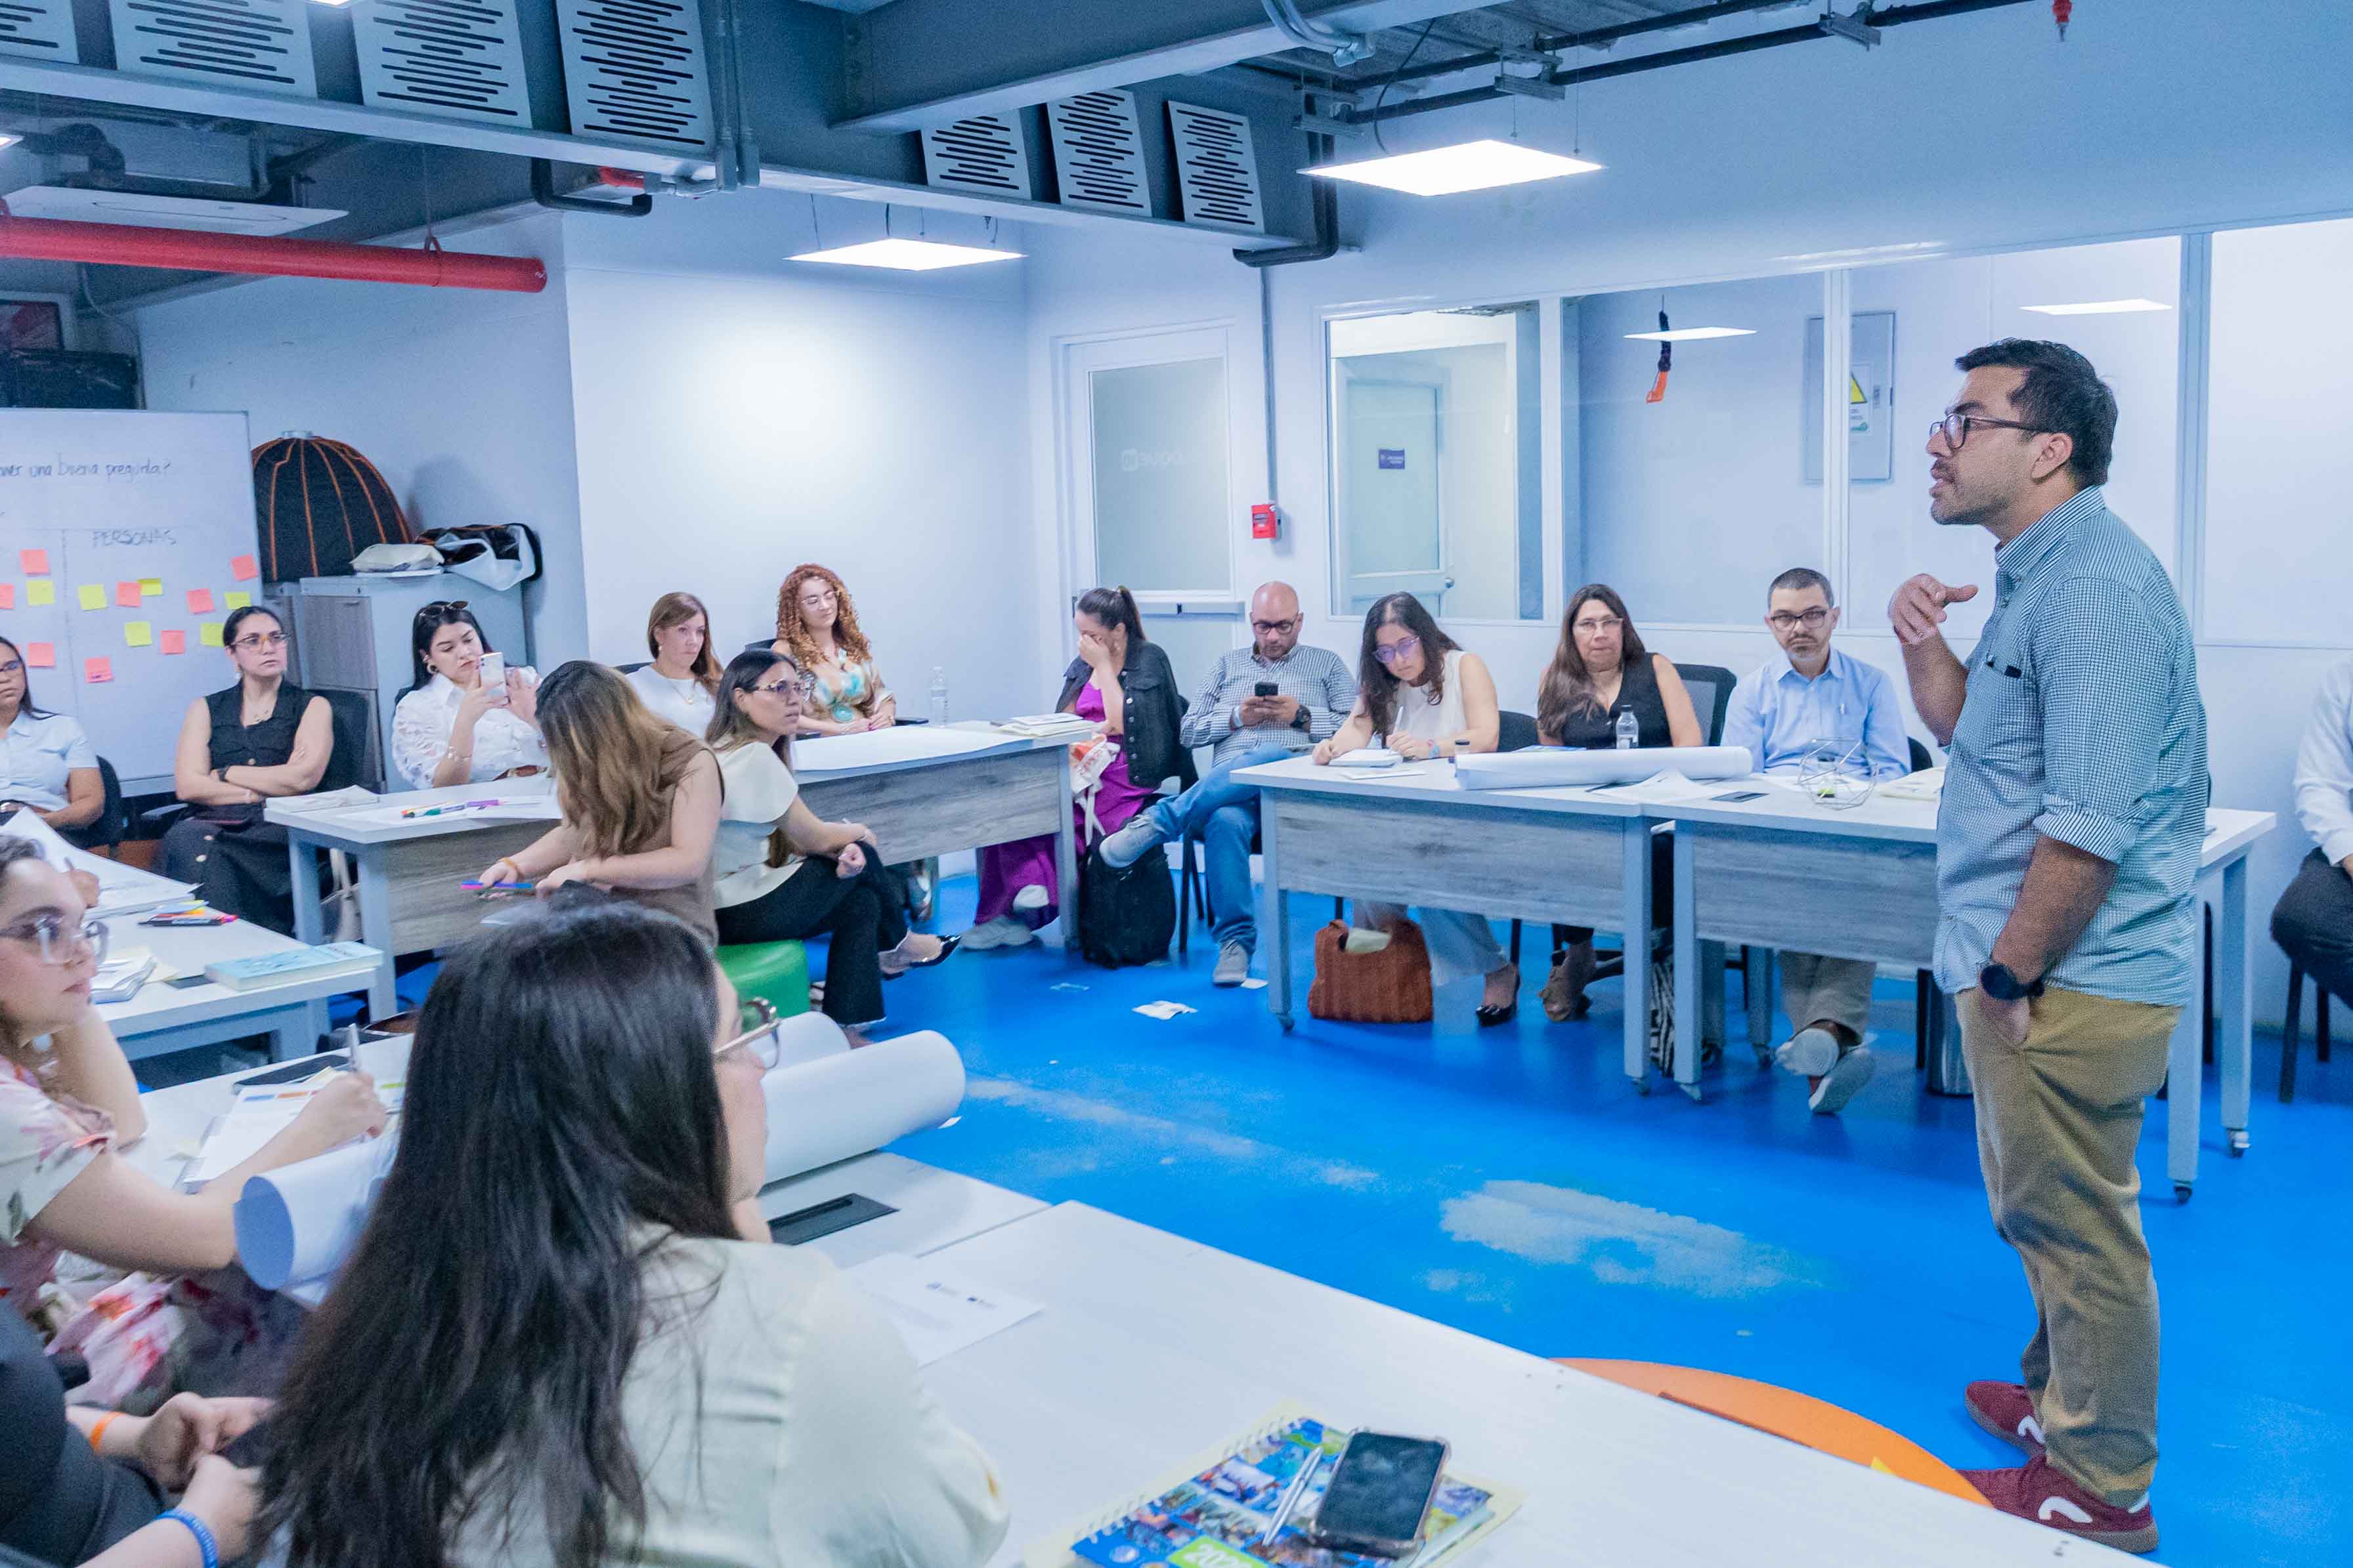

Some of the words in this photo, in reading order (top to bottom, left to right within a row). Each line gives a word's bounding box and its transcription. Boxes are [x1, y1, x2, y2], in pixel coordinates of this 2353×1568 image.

[29, 465, 53, 478] una
[57, 453, 99, 477] buena
[92, 528, 177, 547] PERSONAS
